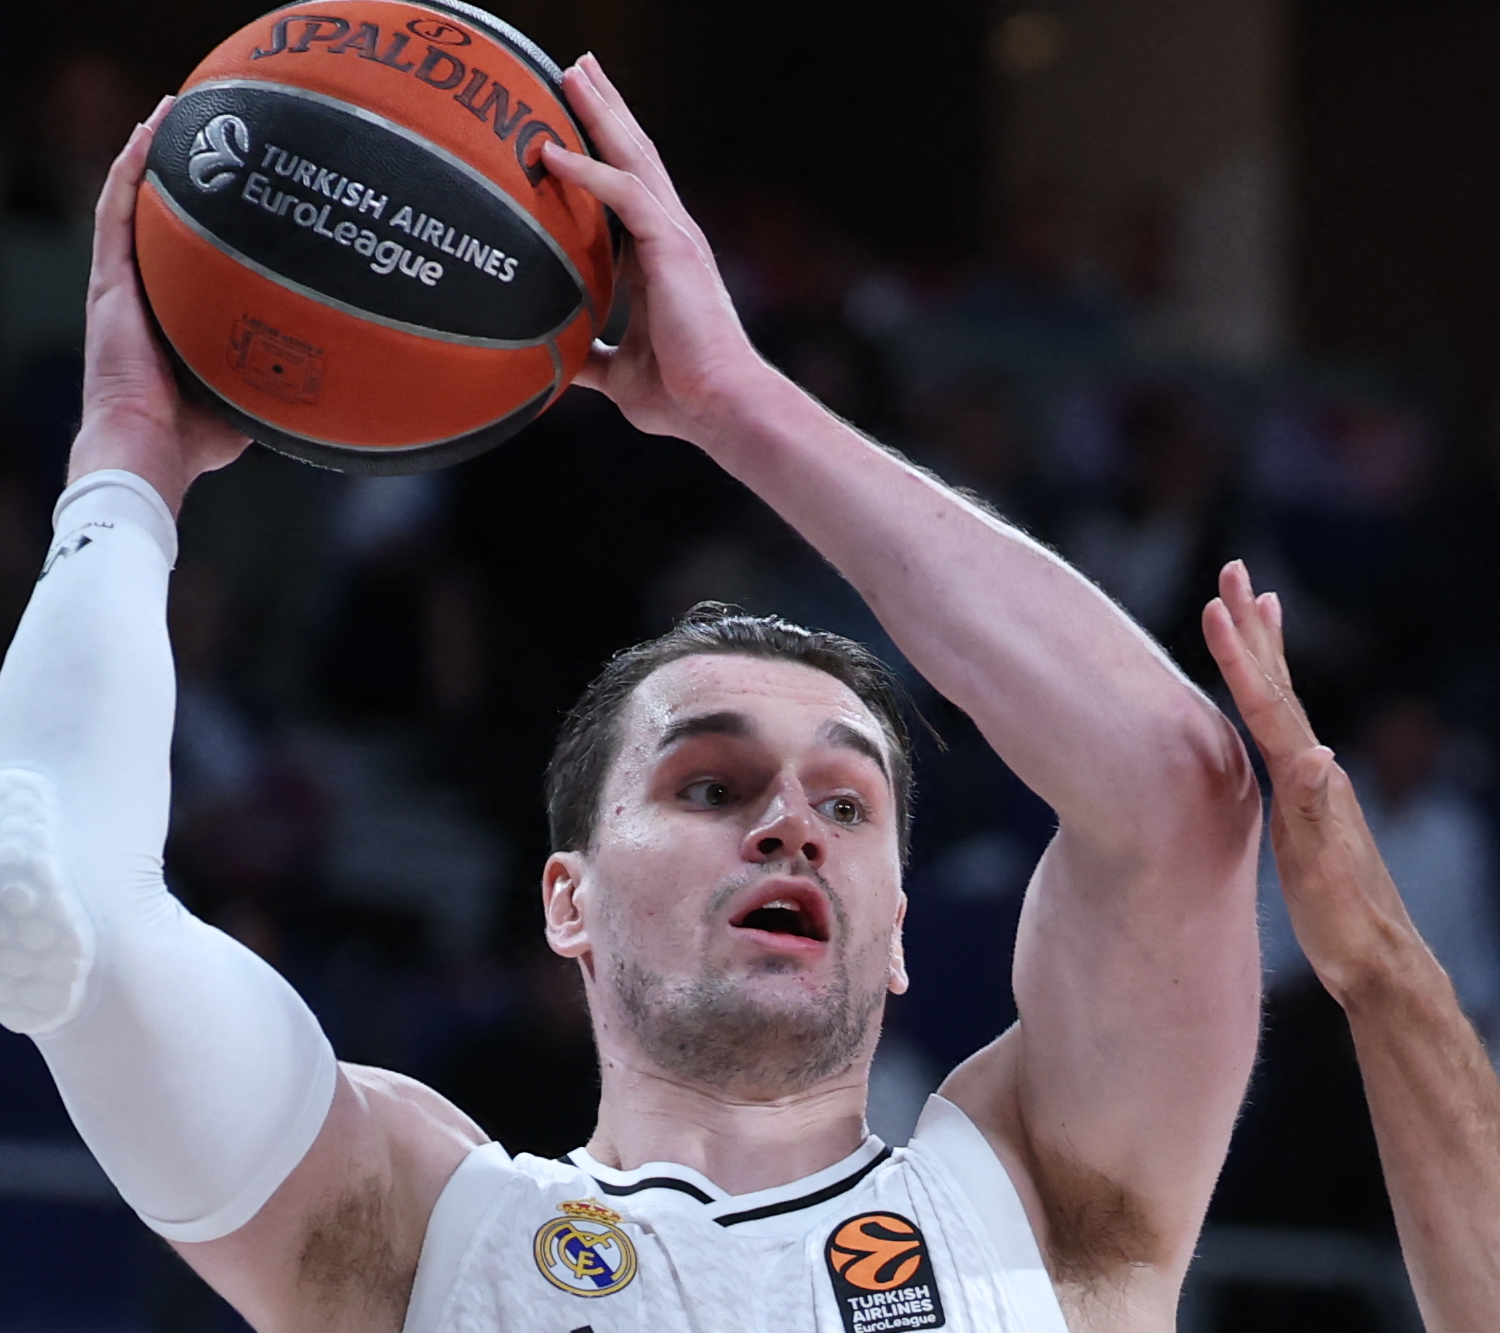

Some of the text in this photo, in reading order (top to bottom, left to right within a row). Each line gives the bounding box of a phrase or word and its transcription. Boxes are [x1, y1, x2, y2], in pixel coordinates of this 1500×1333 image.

[251, 15, 566, 188] SPALDING
[241, 171, 444, 286] EuroLeague
[261, 143, 519, 283] TURKISH AIRLINES
[847, 1285, 930, 1311] TURKISH
[852, 1298, 934, 1323] AIRLINES
[853, 1313, 936, 1333] EuroLeague
